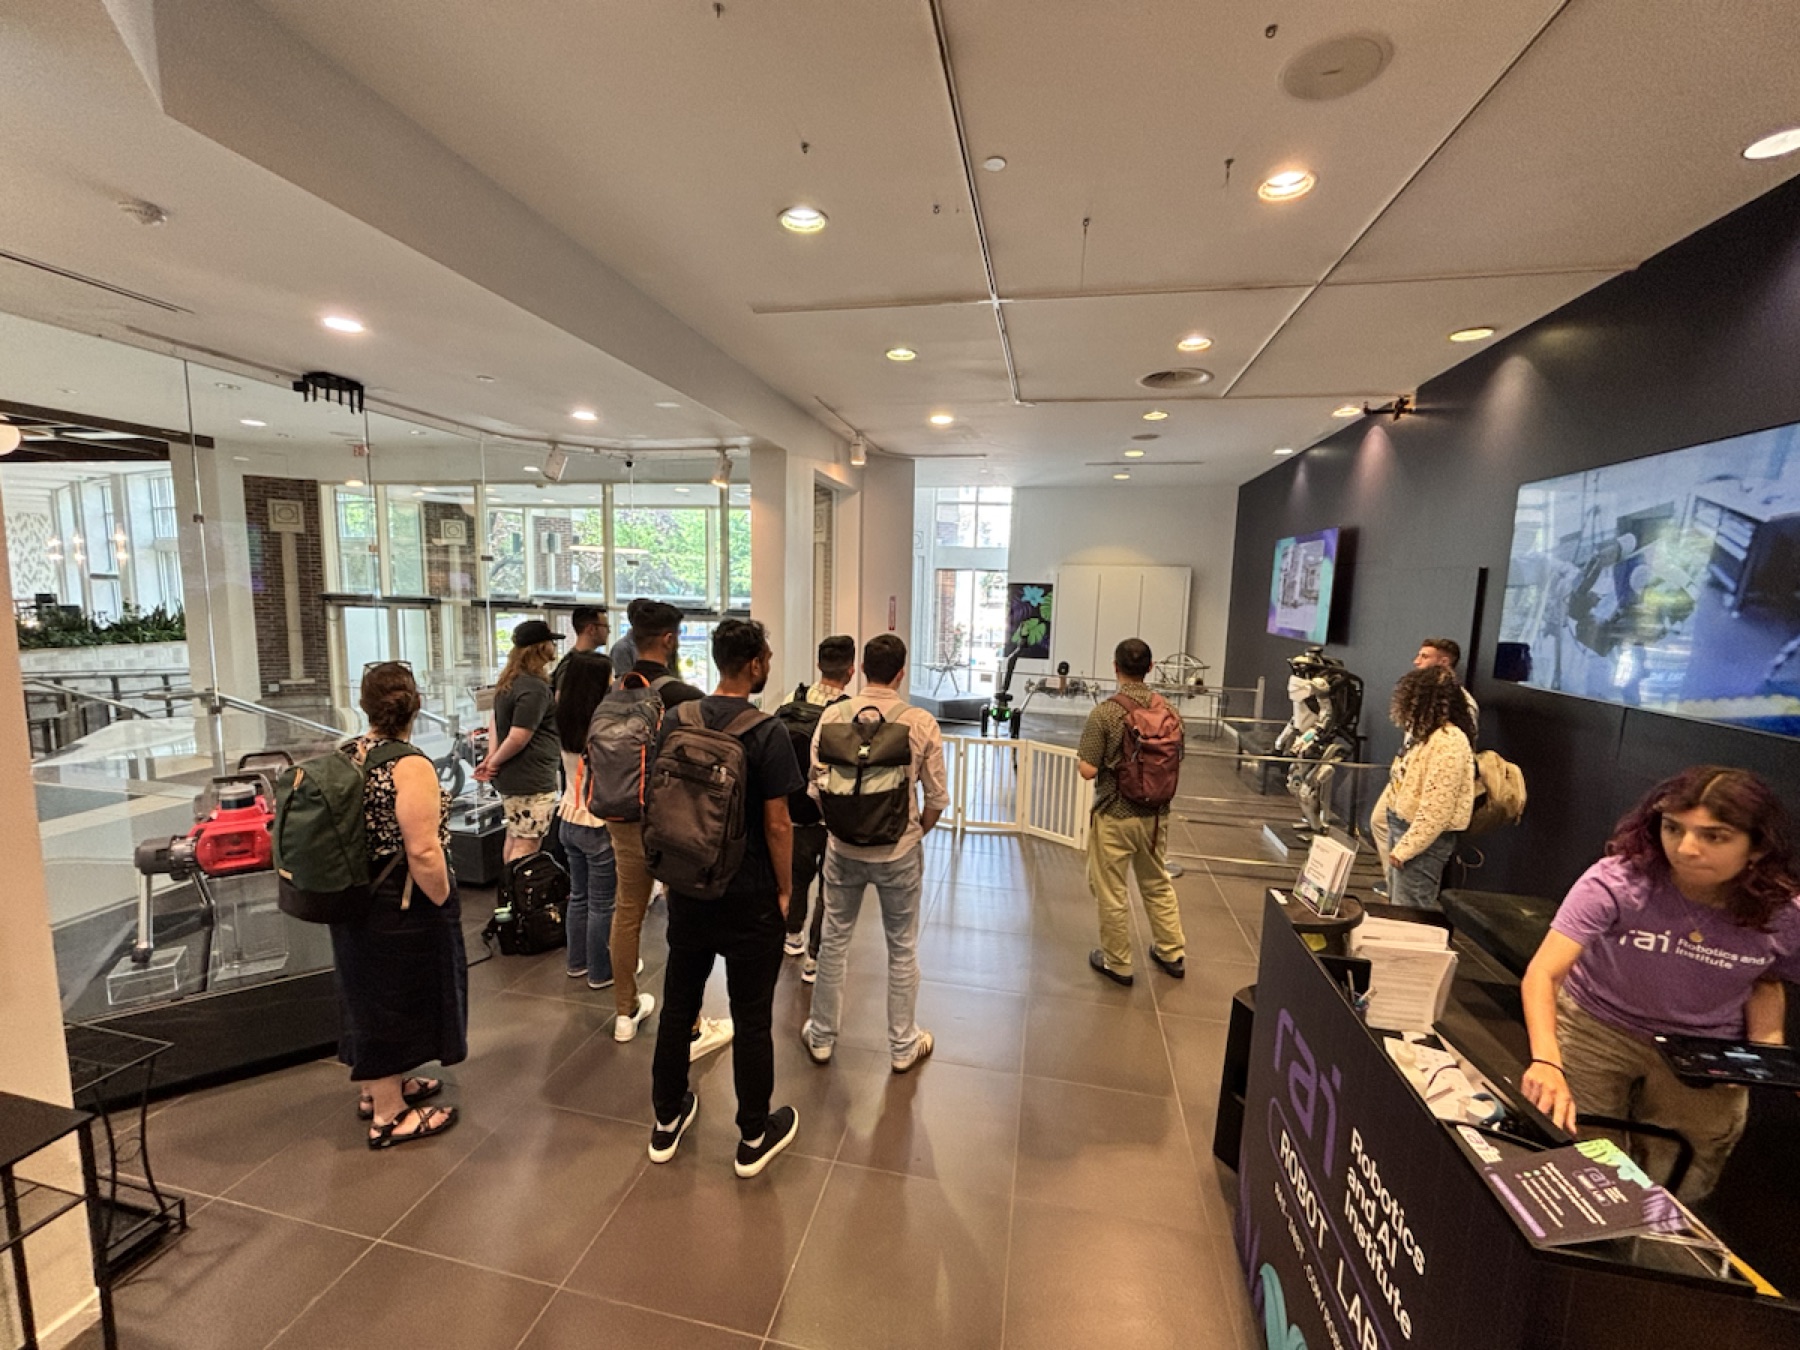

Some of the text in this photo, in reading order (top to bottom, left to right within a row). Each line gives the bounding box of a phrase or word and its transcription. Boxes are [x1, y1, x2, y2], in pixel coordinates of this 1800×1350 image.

[1675, 947, 1734, 970] Institute
[1677, 938, 1739, 961] Robotics
[1740, 955, 1766, 965] and
[1274, 1008, 1342, 1178] rai
[1280, 1129, 1329, 1249] ROBOT
[1347, 1166, 1397, 1269] and AI
[1350, 1127, 1425, 1276] Robotics
[1344, 1190, 1412, 1340] Institute
